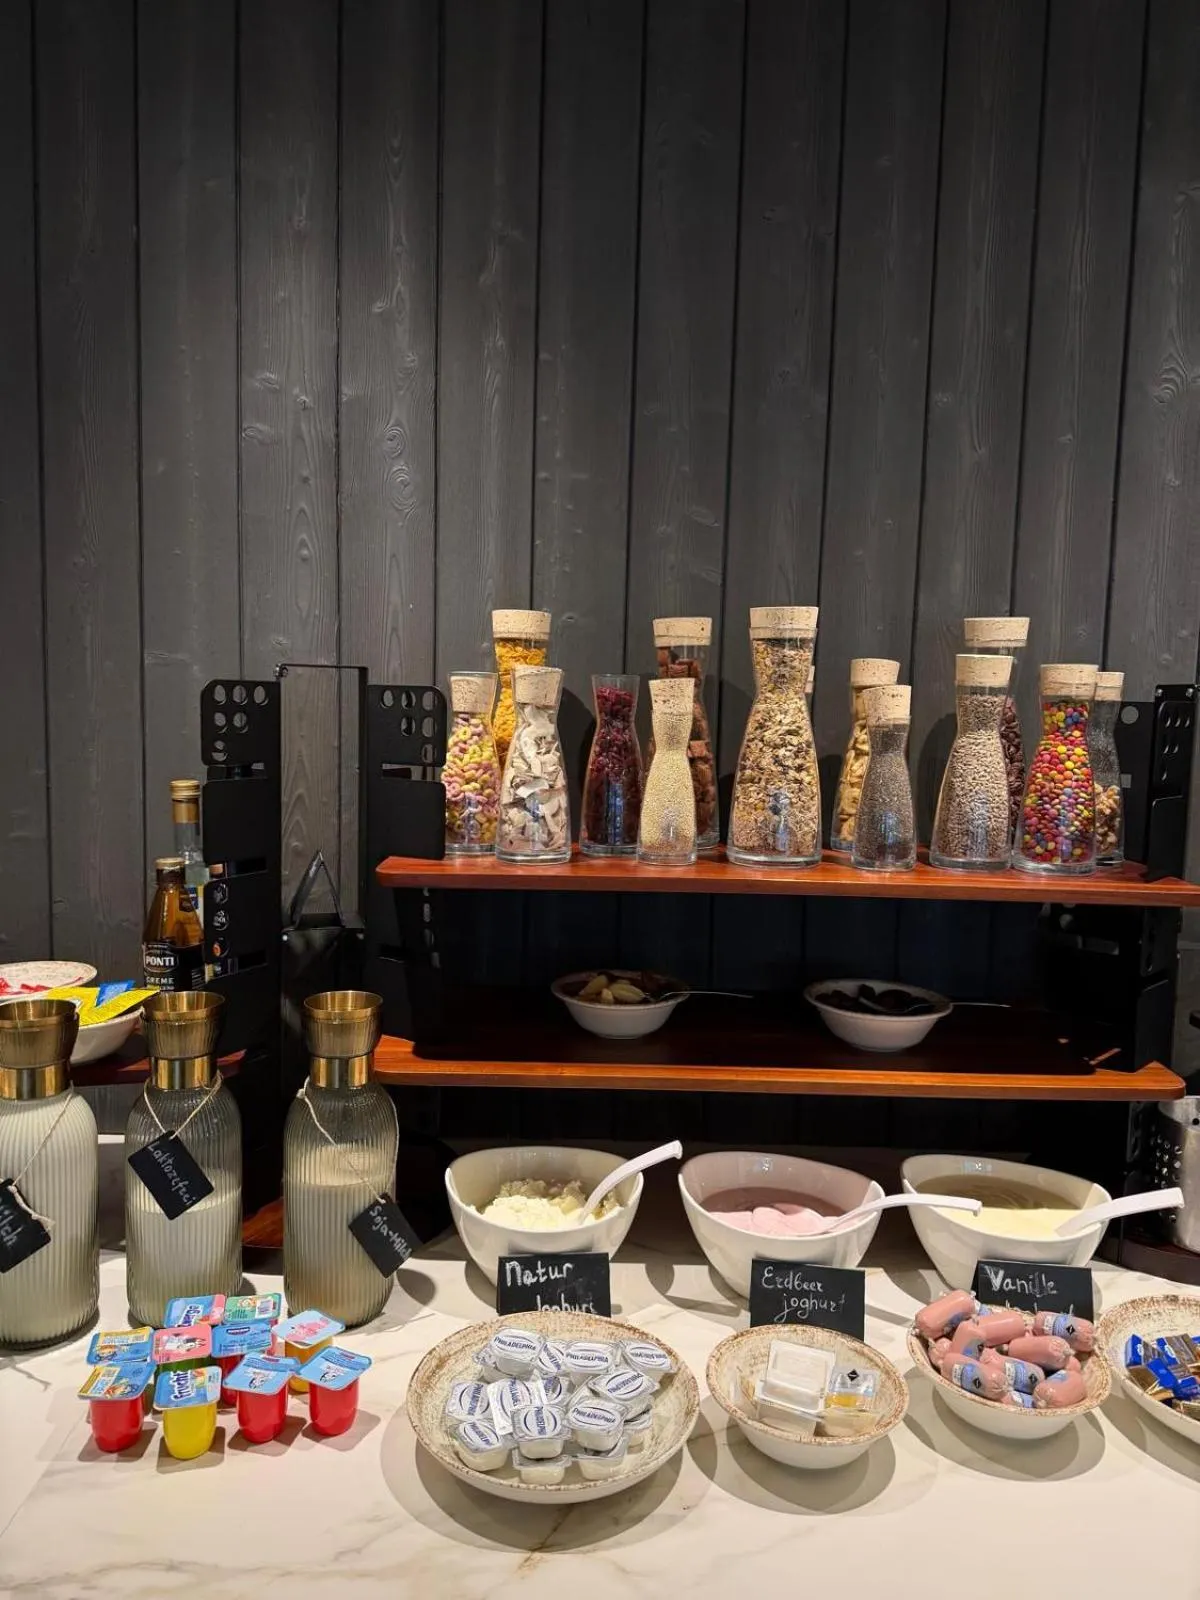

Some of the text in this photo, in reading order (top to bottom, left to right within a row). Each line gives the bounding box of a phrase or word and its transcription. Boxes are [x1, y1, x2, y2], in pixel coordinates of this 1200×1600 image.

[145, 956, 175, 966] PONTI
[506, 1260, 574, 1287] Natur
[761, 1266, 823, 1292] Erdbeer
[983, 1265, 1058, 1298] Vanille
[493, 1336, 536, 1351] PHILADELPHIA
[572, 1407, 616, 1423] PHILADELPHIA
